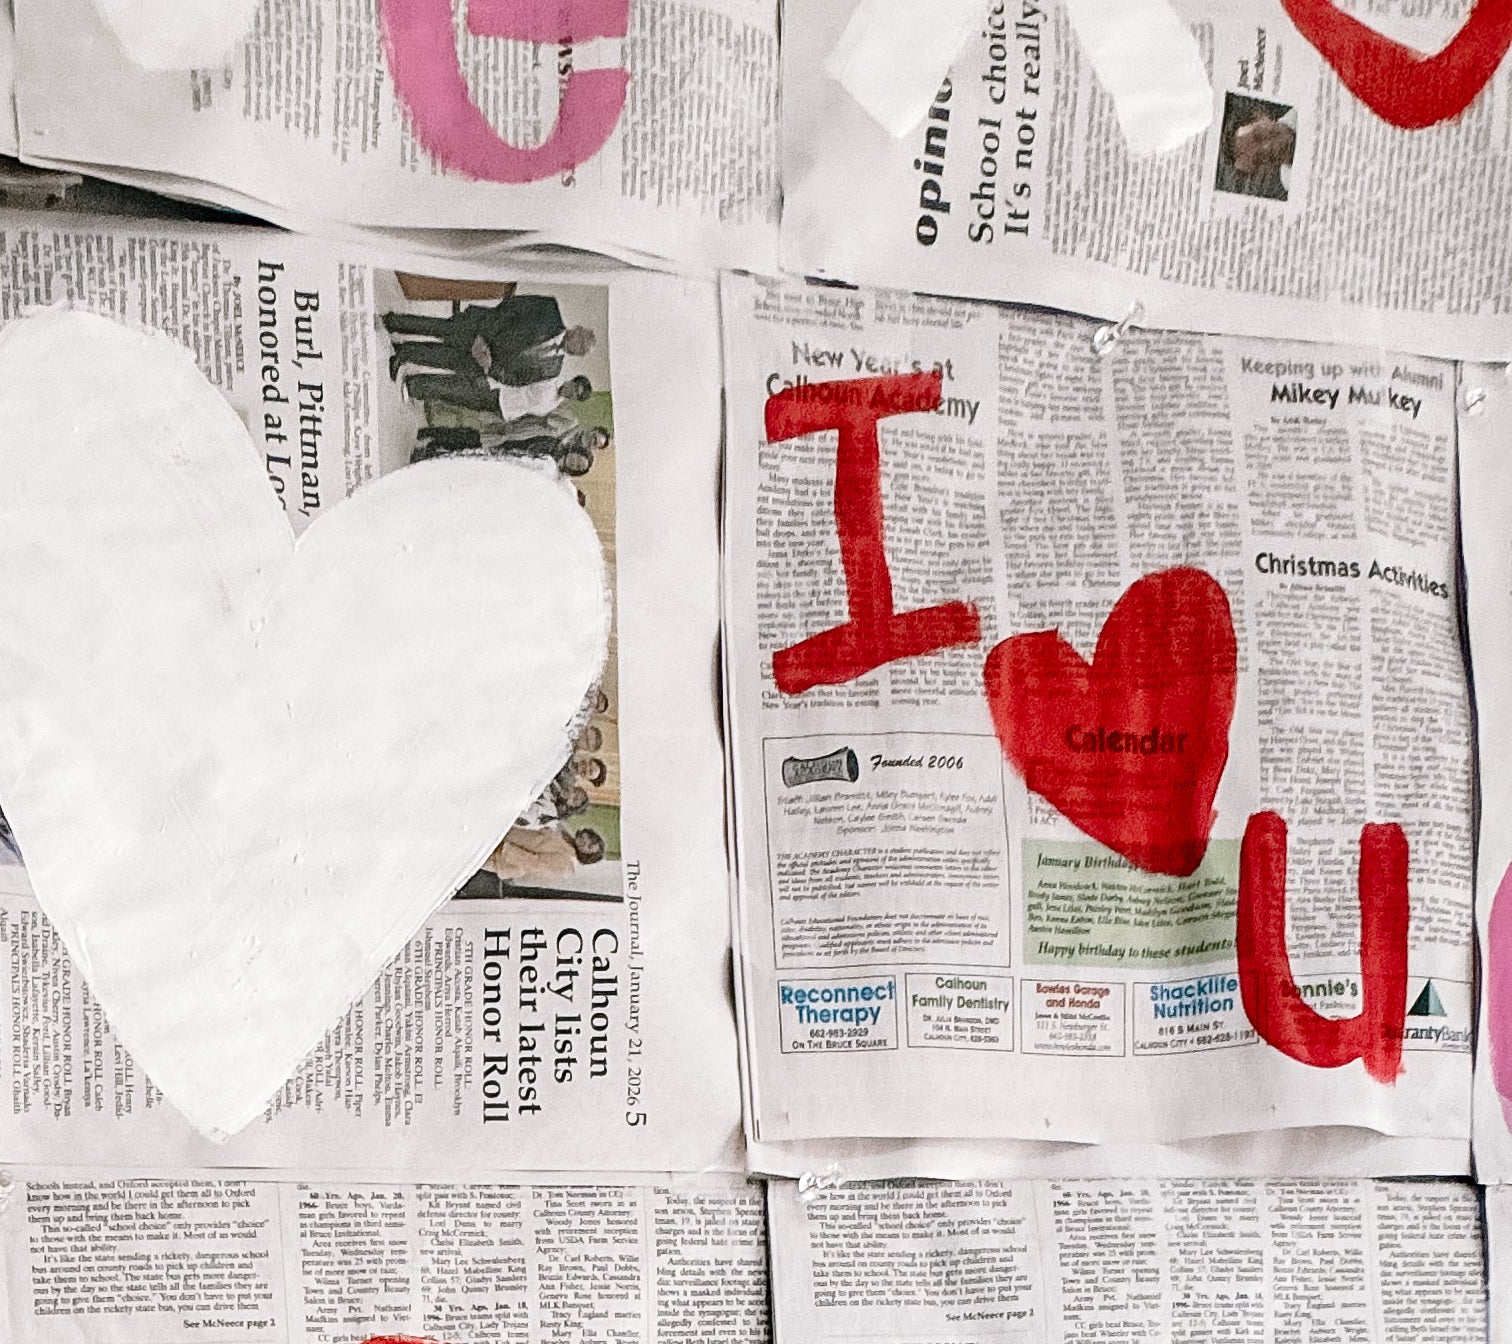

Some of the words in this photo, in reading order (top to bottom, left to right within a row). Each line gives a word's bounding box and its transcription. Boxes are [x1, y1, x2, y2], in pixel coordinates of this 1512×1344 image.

[967, 118, 1001, 243] School
[257, 258, 289, 403] honored
[291, 289, 323, 369] Burl,
[1270, 382, 1339, 410] Mikey
[263, 413, 287, 439] at
[297, 379, 324, 516] Pittman,
[765, 369, 982, 695] I
[1254, 552, 1360, 578] Christmas
[1367, 562, 1451, 600] Activities
[870, 753, 924, 771] Founded
[927, 754, 963, 769] 2006
[1065, 725, 1189, 758] Calendar
[626, 860, 640, 890] The
[626, 894, 643, 959] Journal,
[482, 927, 511, 1042] Honor
[518, 926, 547, 1012] their
[549, 927, 583, 1002] City
[934, 976, 987, 990] Calhoun
[589, 928, 618, 1078] Calhoun
[627, 963, 643, 1033] January
[777, 980, 897, 1006] Reconnect
[795, 1000, 881, 1026] Therapy
[910, 995, 955, 1011] Family
[956, 994, 1014, 1014] Dentistry
[1153, 996, 1233, 1019] Nutrition
[518, 1023, 545, 1115] latest
[553, 1013, 581, 1083] lists
[627, 1038, 642, 1056] 21,
[482, 1053, 509, 1123] Roll
[627, 1067, 643, 1107] 2026
[625, 1111, 648, 1127] 5
[183, 1319, 200, 1328] See
[201, 1318, 244, 1327] McNeece
[246, 1320, 268, 1329] page
[269, 1318, 275, 1326] 2
